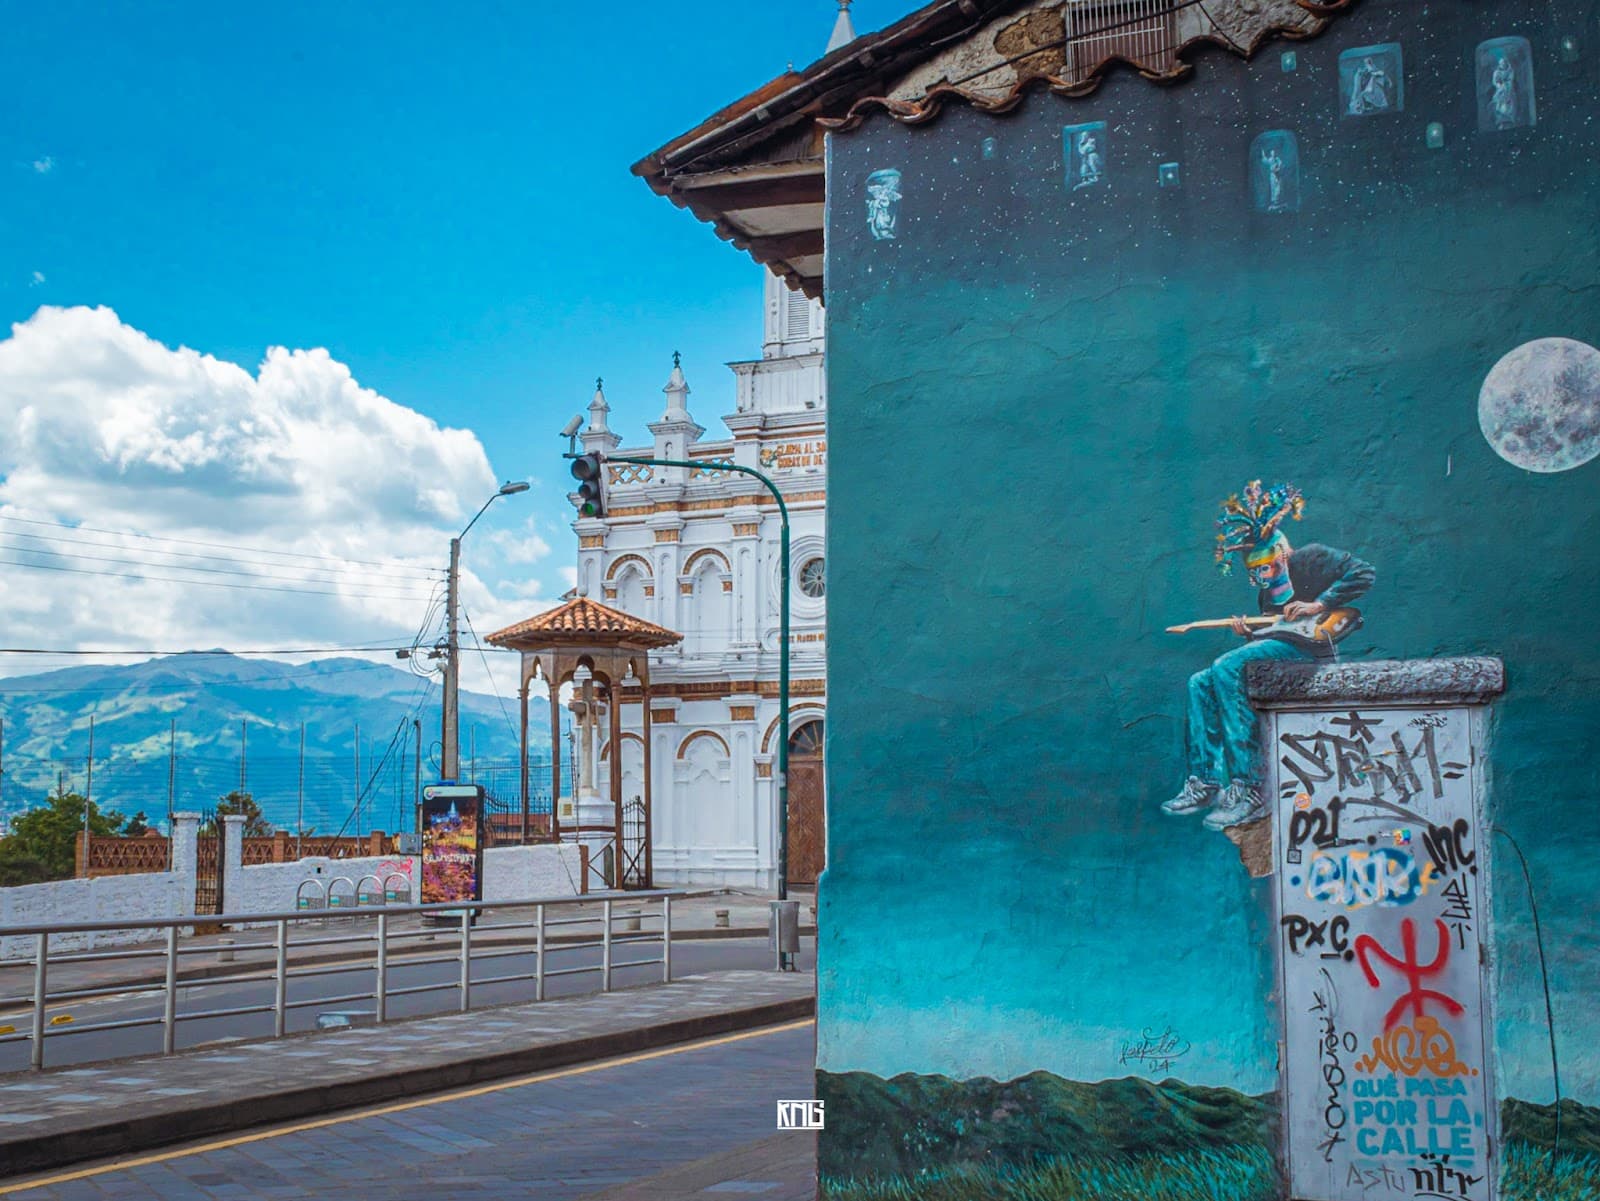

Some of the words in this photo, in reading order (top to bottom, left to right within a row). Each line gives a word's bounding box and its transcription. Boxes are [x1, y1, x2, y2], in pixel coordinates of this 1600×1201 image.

[1405, 1078, 1467, 1097] PASA
[1354, 1100, 1417, 1126] POR
[1427, 1098, 1472, 1126] LA
[1356, 1127, 1475, 1156] CALLE
